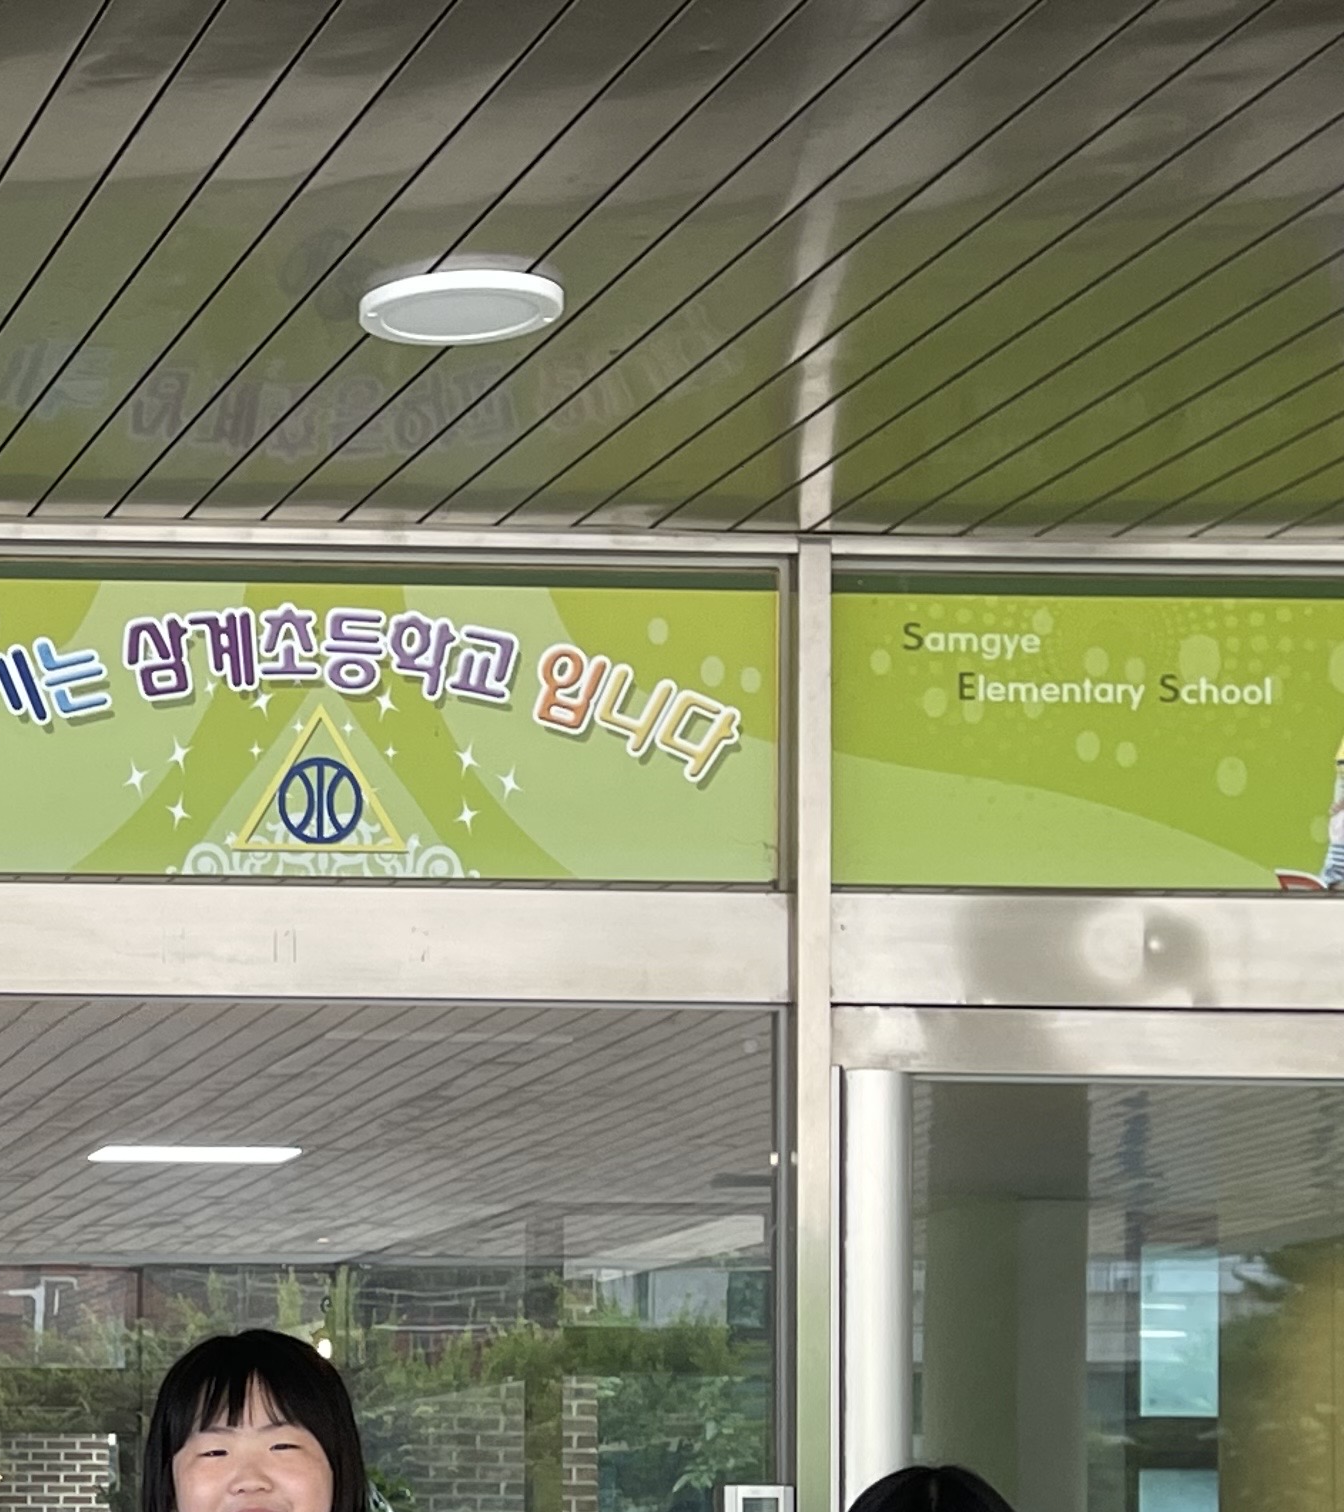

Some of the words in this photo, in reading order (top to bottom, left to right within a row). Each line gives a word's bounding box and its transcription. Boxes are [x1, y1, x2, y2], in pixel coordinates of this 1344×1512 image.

[903, 623, 1041, 660] Samgye
[122, 603, 519, 702] 삼계초등학교
[534, 645, 742, 781] 입니다
[958, 672, 1145, 711] Elementary
[1159, 674, 1273, 705] School
